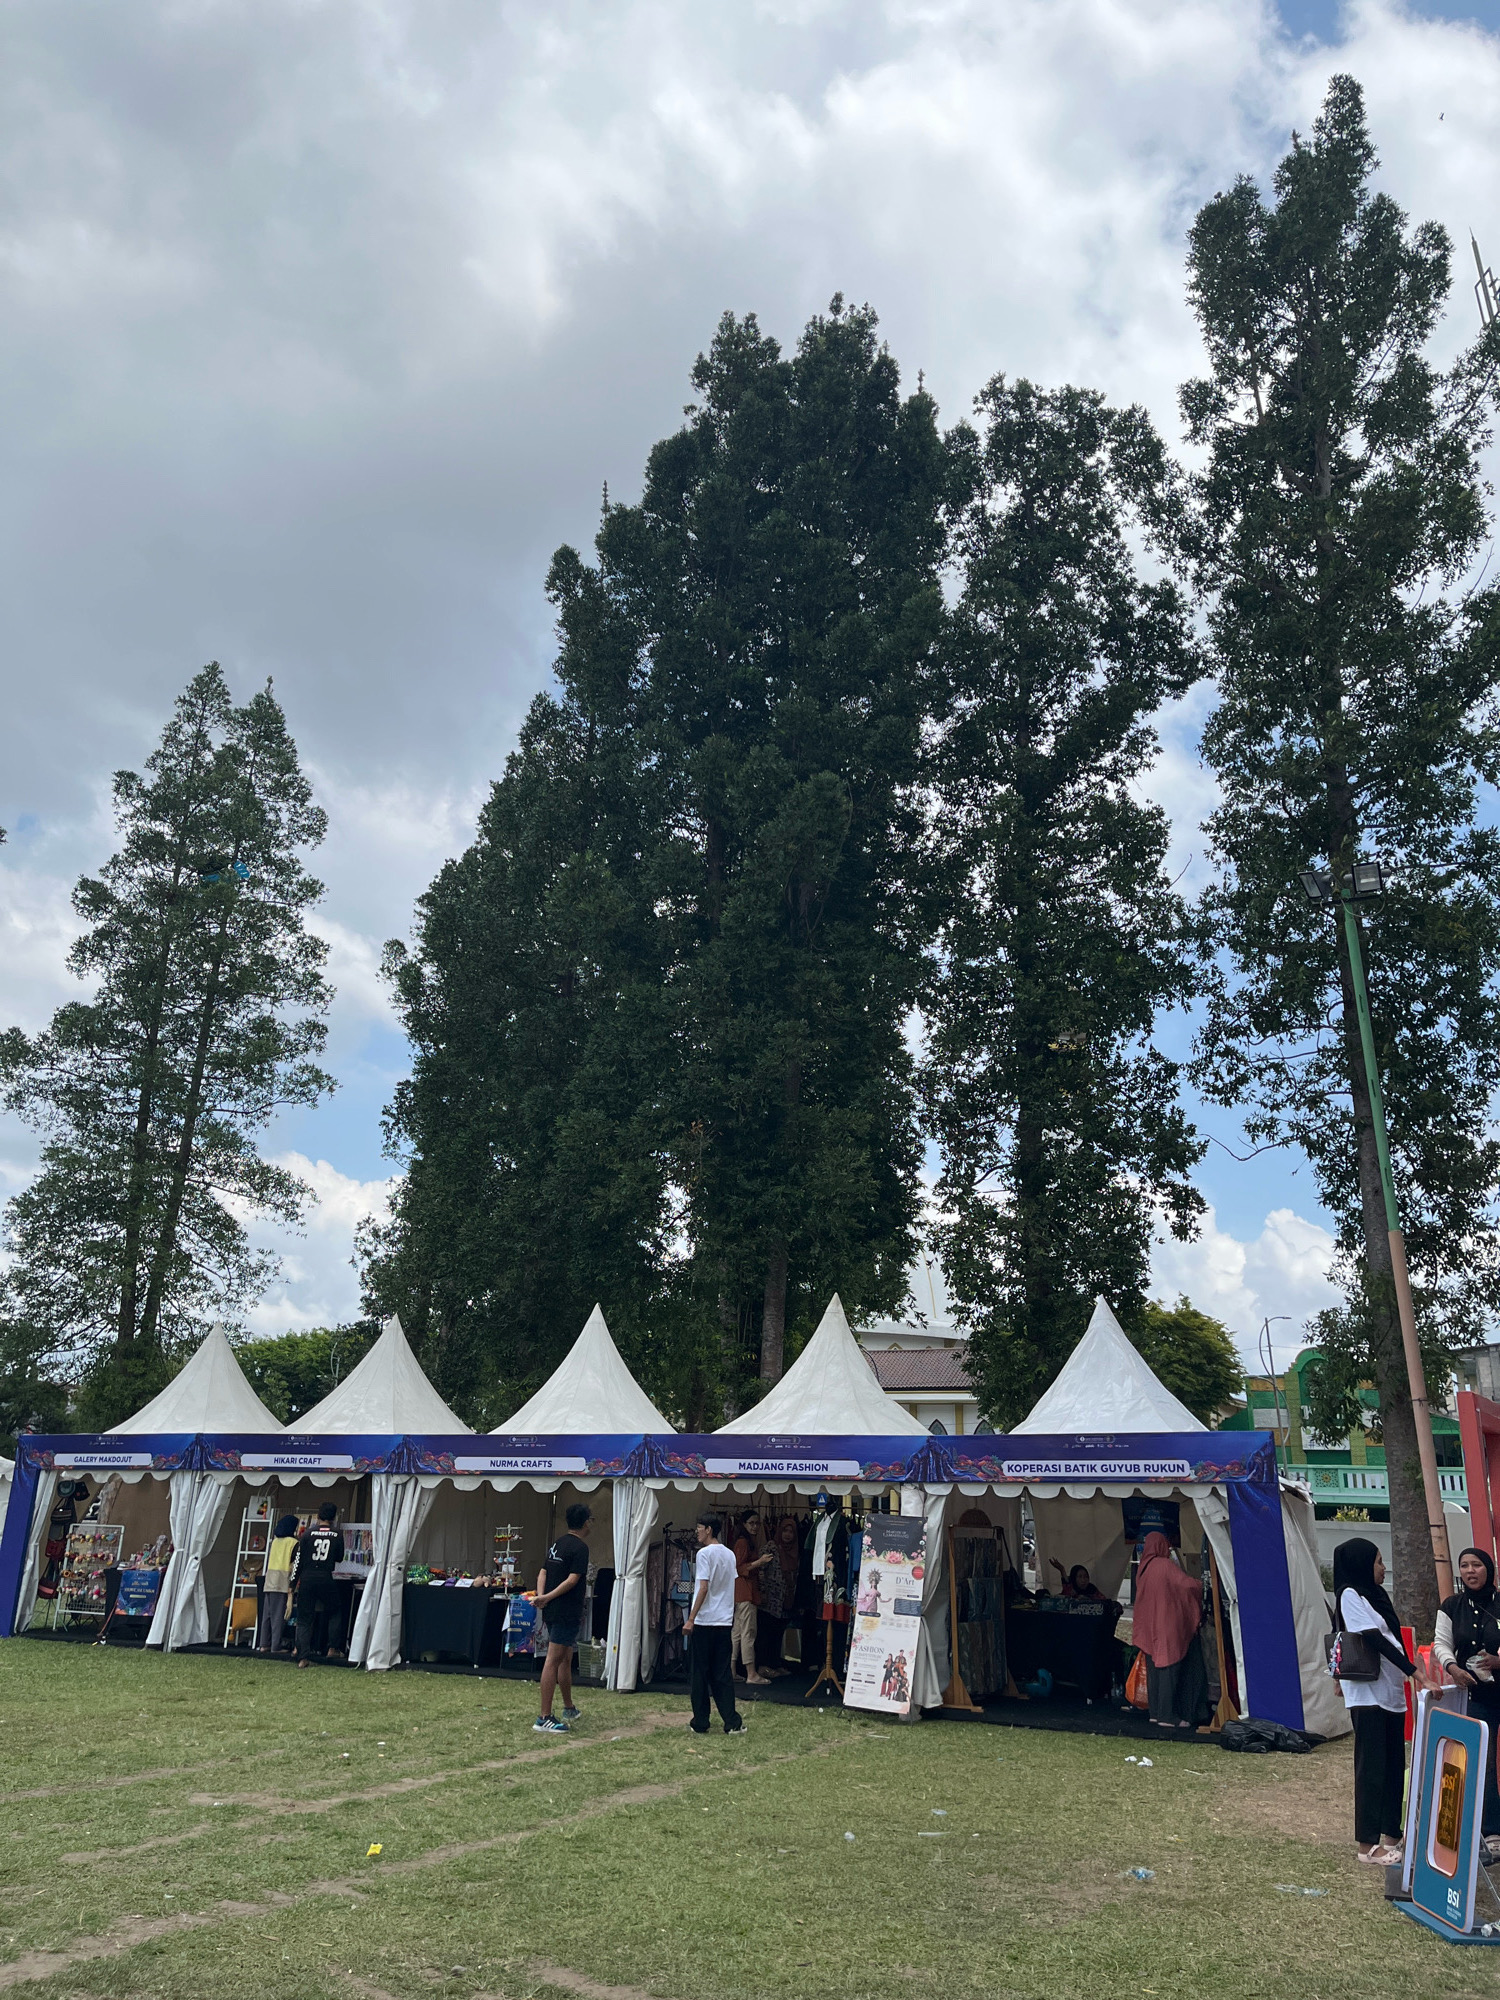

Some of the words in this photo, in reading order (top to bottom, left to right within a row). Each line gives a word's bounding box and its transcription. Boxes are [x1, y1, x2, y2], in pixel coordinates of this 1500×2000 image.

[298, 1457, 322, 1465] CRAFT
[490, 1459, 519, 1467] NURMA
[521, 1460, 553, 1468] CRAFTS
[738, 1462, 784, 1471] MADJANG
[786, 1463, 829, 1472] FASHION
[1007, 1464, 1061, 1473] KOPERASI
[1064, 1464, 1098, 1473] BATIK
[1100, 1464, 1141, 1473] GUYUB
[1144, 1464, 1185, 1473] RUKUN
[311, 1538, 331, 1561] 39
[895, 1576, 915, 1586] D'Art
[855, 1644, 885, 1654] FASHION
[1447, 1887, 1460, 1908] BSI
